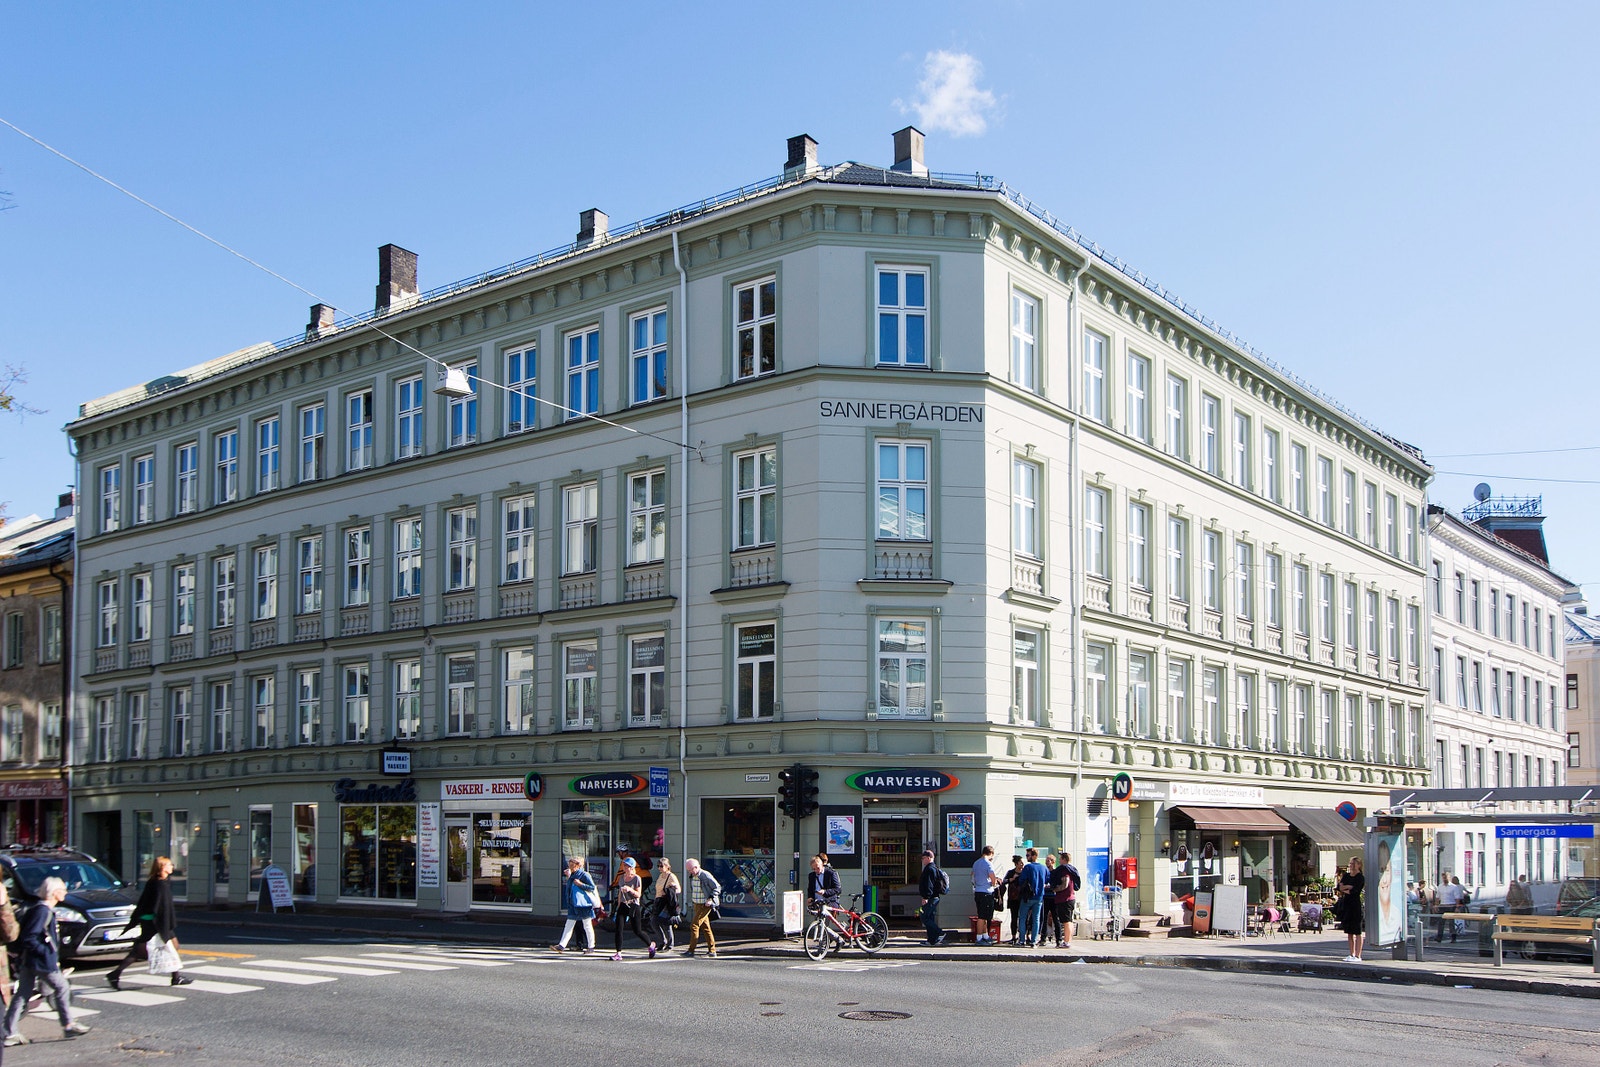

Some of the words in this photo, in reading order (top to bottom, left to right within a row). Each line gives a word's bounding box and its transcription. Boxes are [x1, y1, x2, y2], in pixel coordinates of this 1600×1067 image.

[820, 400, 983, 423] SANNERGÅRDEN
[530, 780, 540, 793] N
[580, 779, 633, 790] NARVESEN
[864, 776, 941, 787] NARVESEN
[1116, 781, 1128, 794] N
[445, 784, 484, 795] VASKERI
[491, 782, 525, 794] RENSER
[651, 782, 668, 794] Taxi
[1501, 827, 1556, 838] Sannergata
[482, 840, 522, 848] INNLEVERING
[722, 891, 737, 903] for
[739, 892, 746, 904] 2
